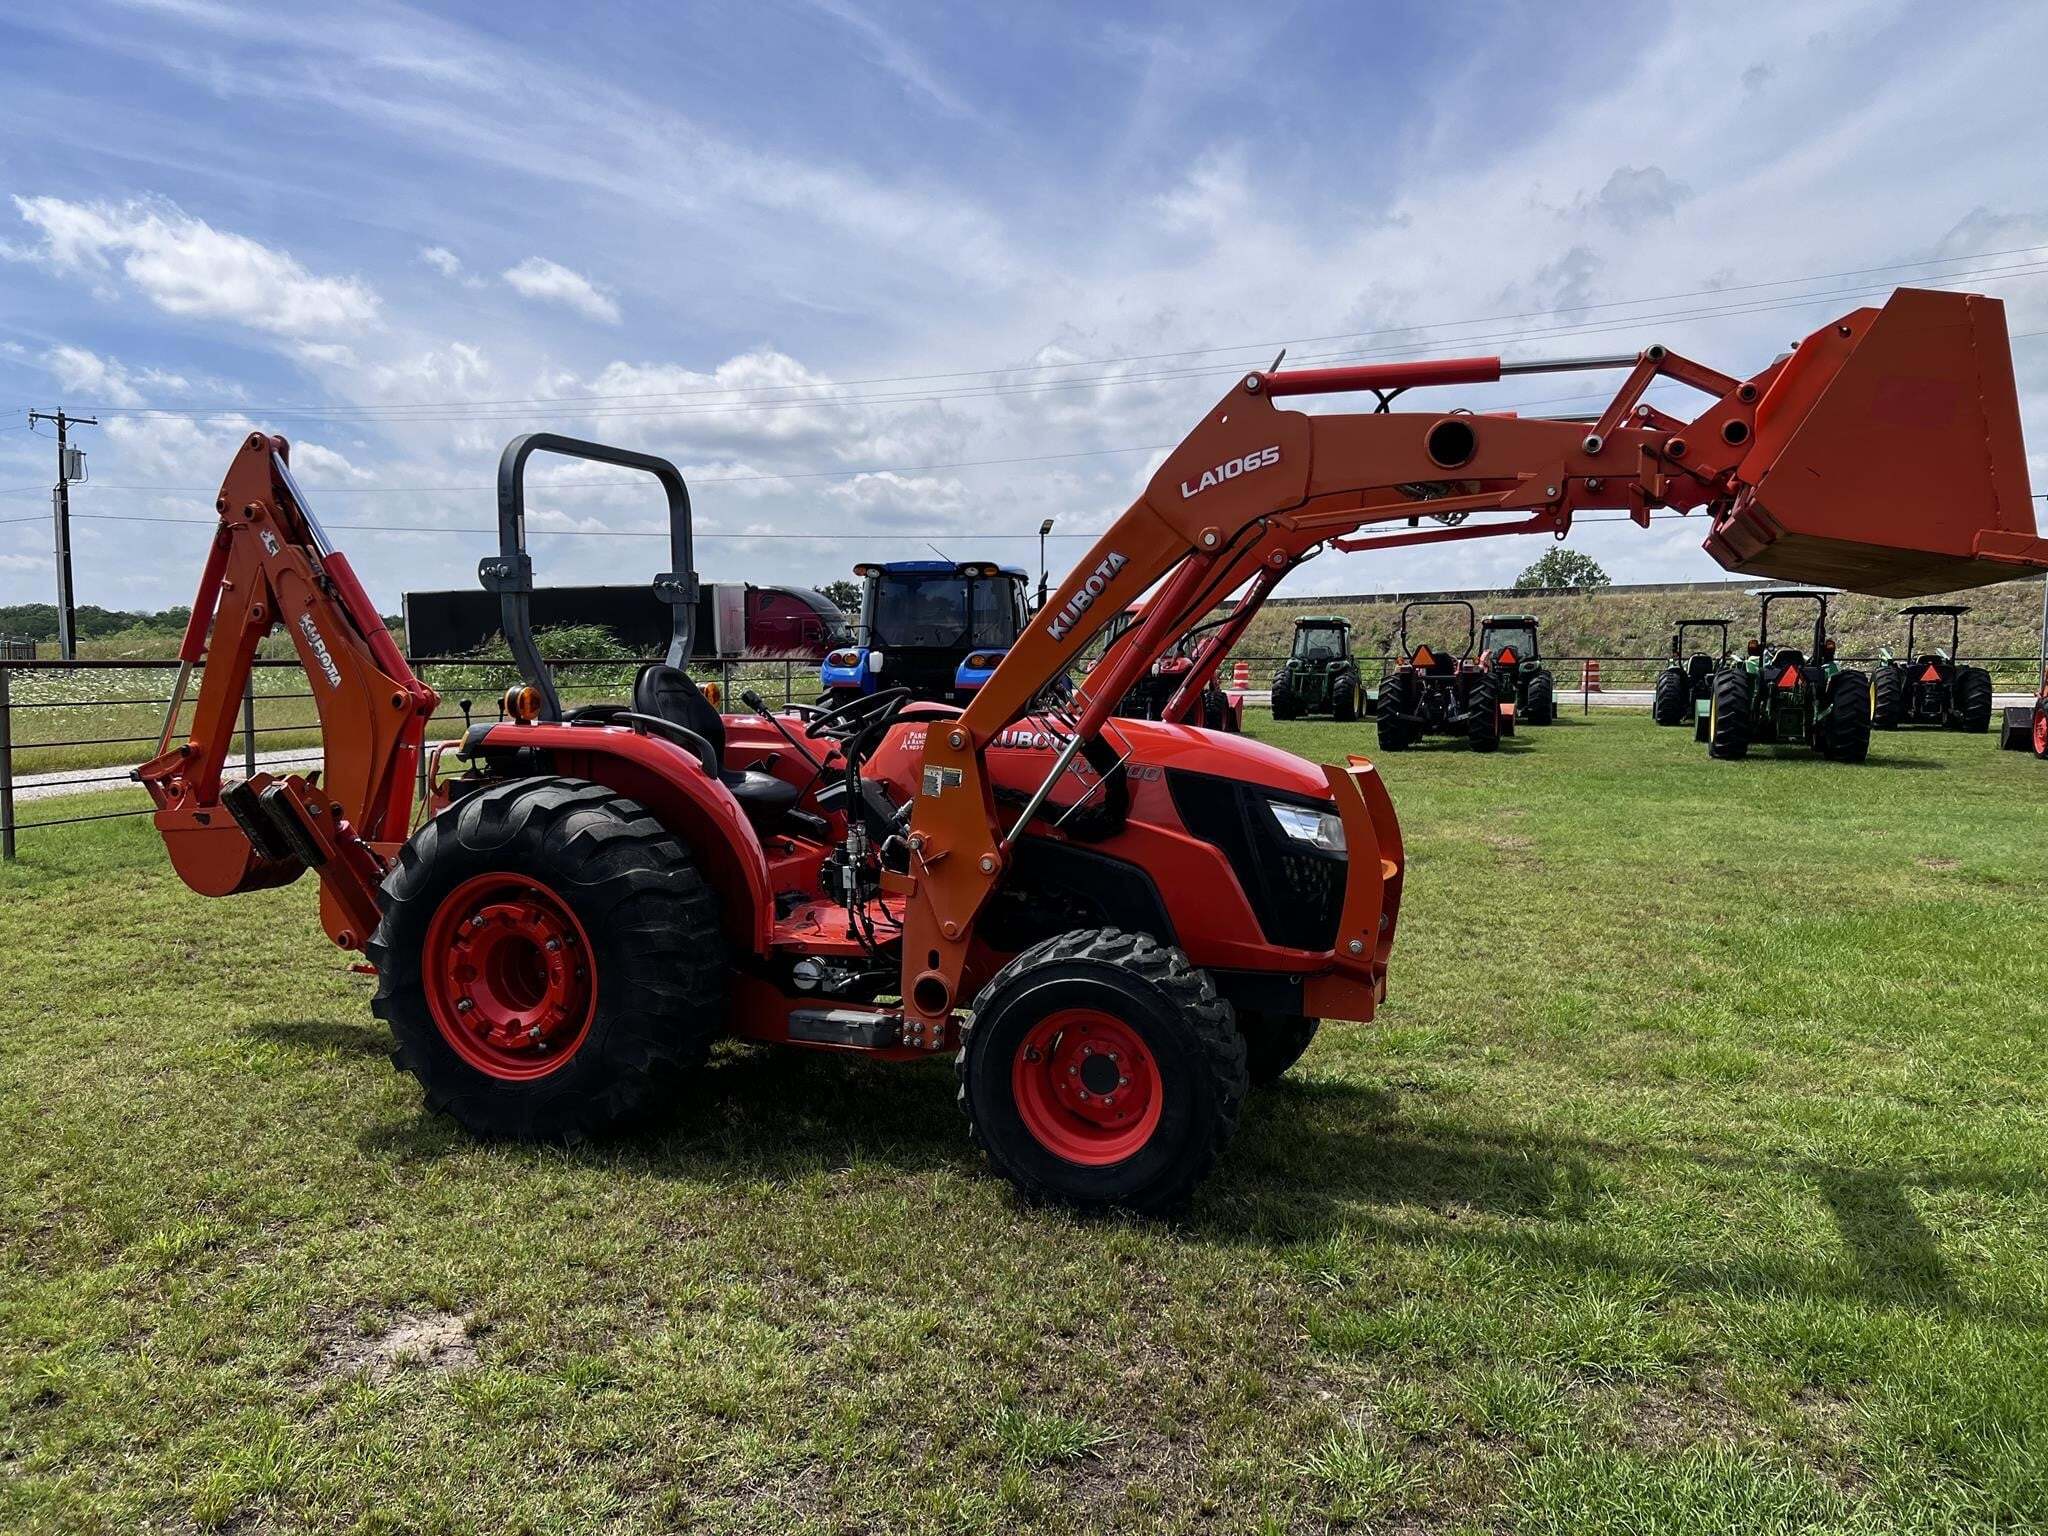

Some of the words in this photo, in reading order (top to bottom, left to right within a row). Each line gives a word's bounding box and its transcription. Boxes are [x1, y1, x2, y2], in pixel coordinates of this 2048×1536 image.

[1181, 446, 1280, 498] LA1065
[1047, 552, 1130, 641] KUBOTA
[299, 613, 342, 688] KUBOTA
